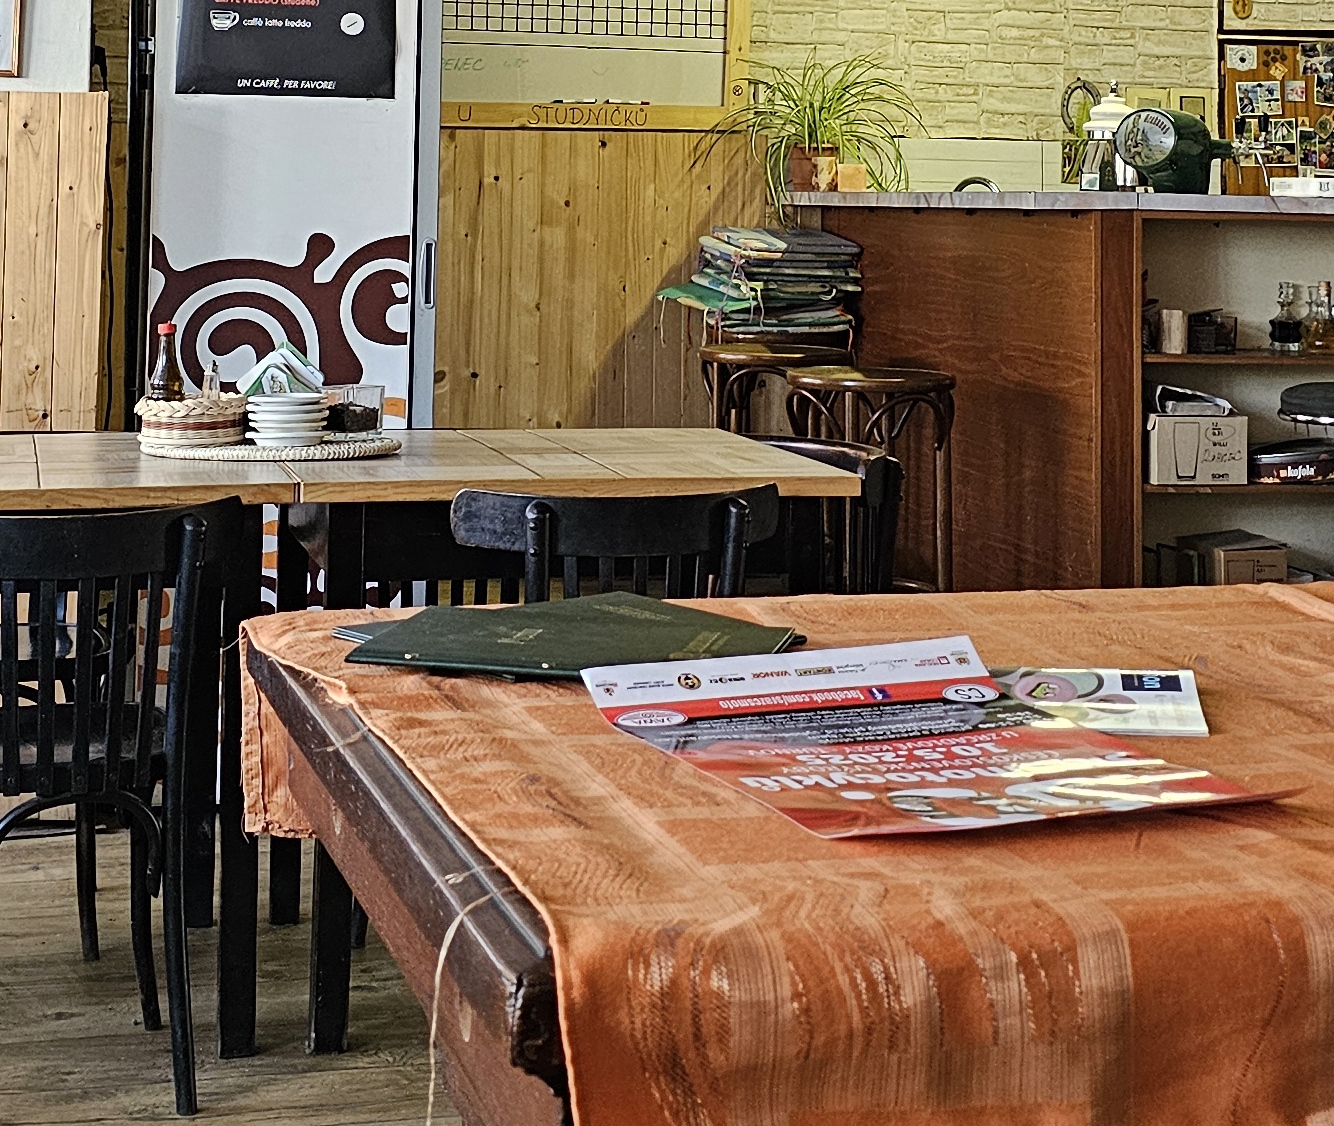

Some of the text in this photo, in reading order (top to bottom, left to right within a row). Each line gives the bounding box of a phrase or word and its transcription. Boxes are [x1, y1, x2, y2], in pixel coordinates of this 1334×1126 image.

[284, 18, 312, 28] freddo
[237, 78, 251, 88] UN
[282, 80, 299, 89] PER
[299, 80, 337, 90] FAVORE!
[457, 104, 649, 126] U STUDNIČKŮ
[1287, 464, 1315, 479] kofola
[954, 687, 986, 700] CS
[630, 715, 674, 727] JAWA
[794, 741, 1008, 764] 10.5.2025
[841, 743, 892, 753] KOZY
